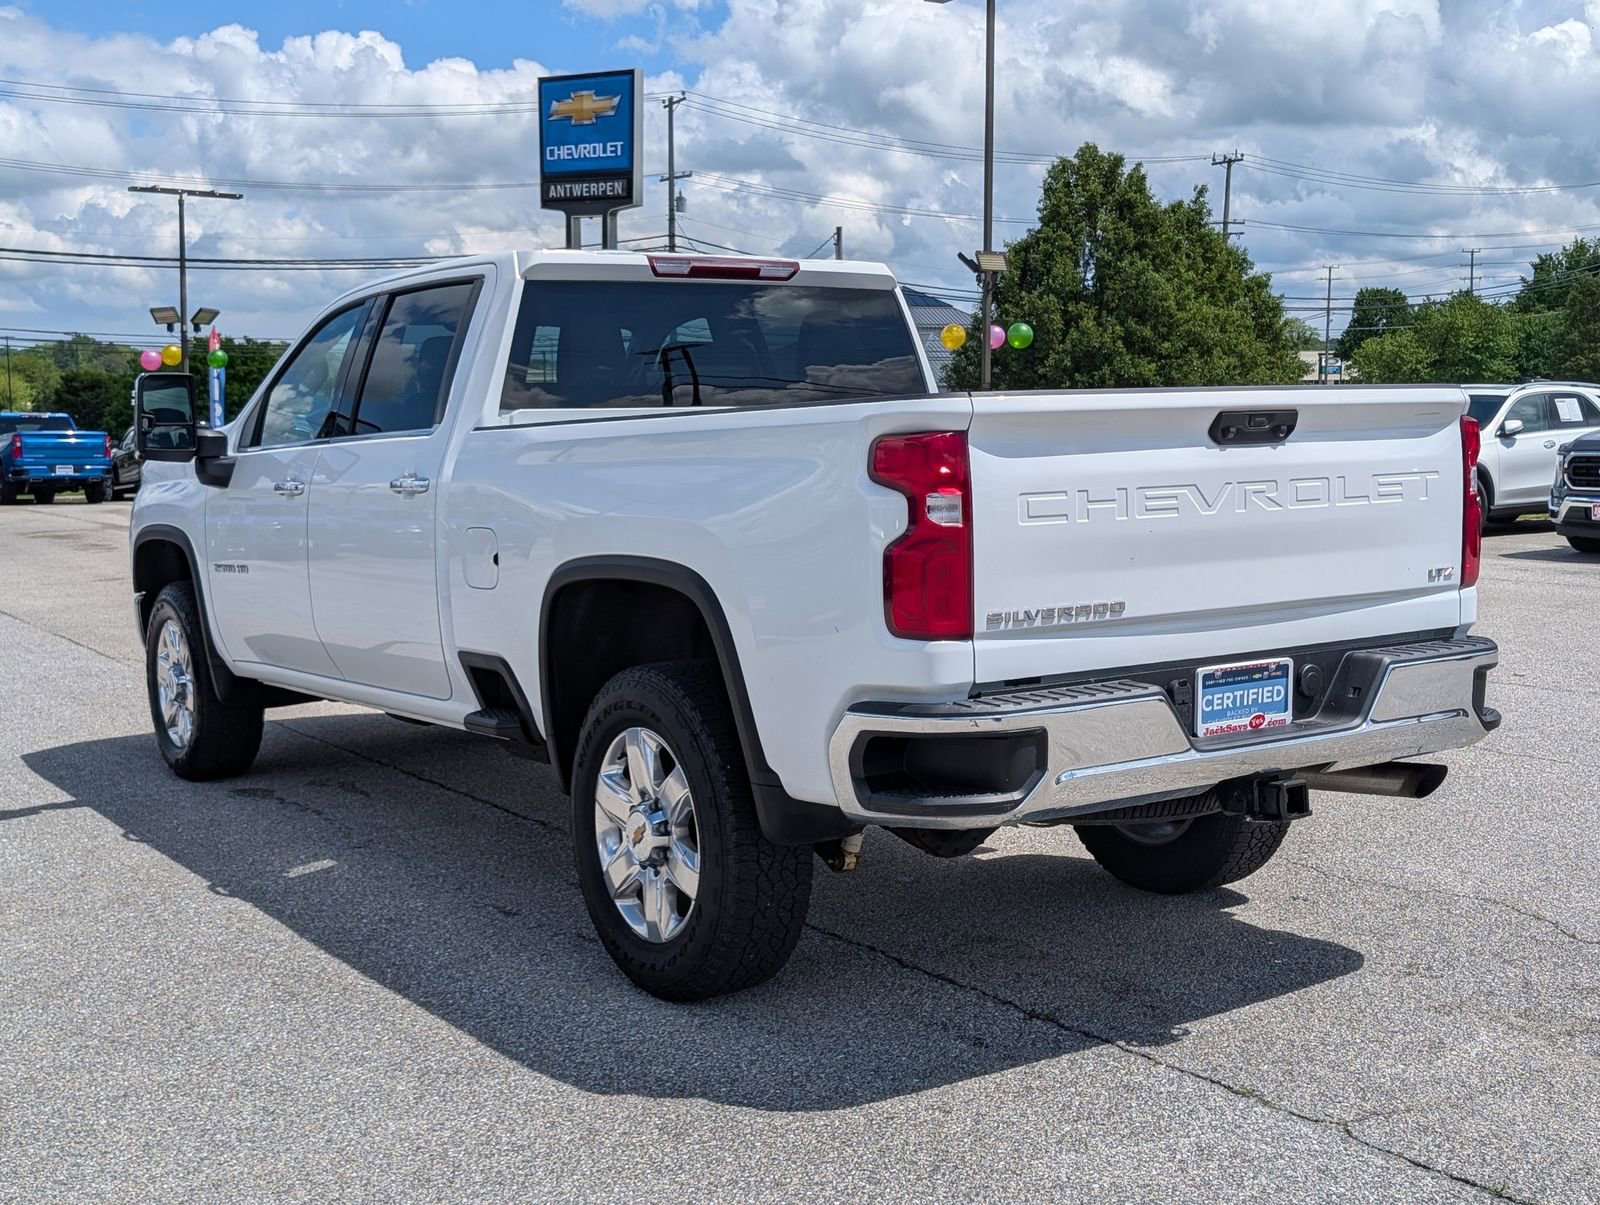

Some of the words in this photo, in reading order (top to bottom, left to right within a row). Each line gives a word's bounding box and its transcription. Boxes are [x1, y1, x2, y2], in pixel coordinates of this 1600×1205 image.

[546, 141, 624, 161] CHEVROLET
[548, 181, 623, 198] ANTWERPEN
[1017, 470, 1440, 526] CHEVROLET
[1428, 567, 1454, 583] LTZ
[986, 601, 1126, 630] SILVERADO
[1202, 685, 1285, 712] CERTIFIED
